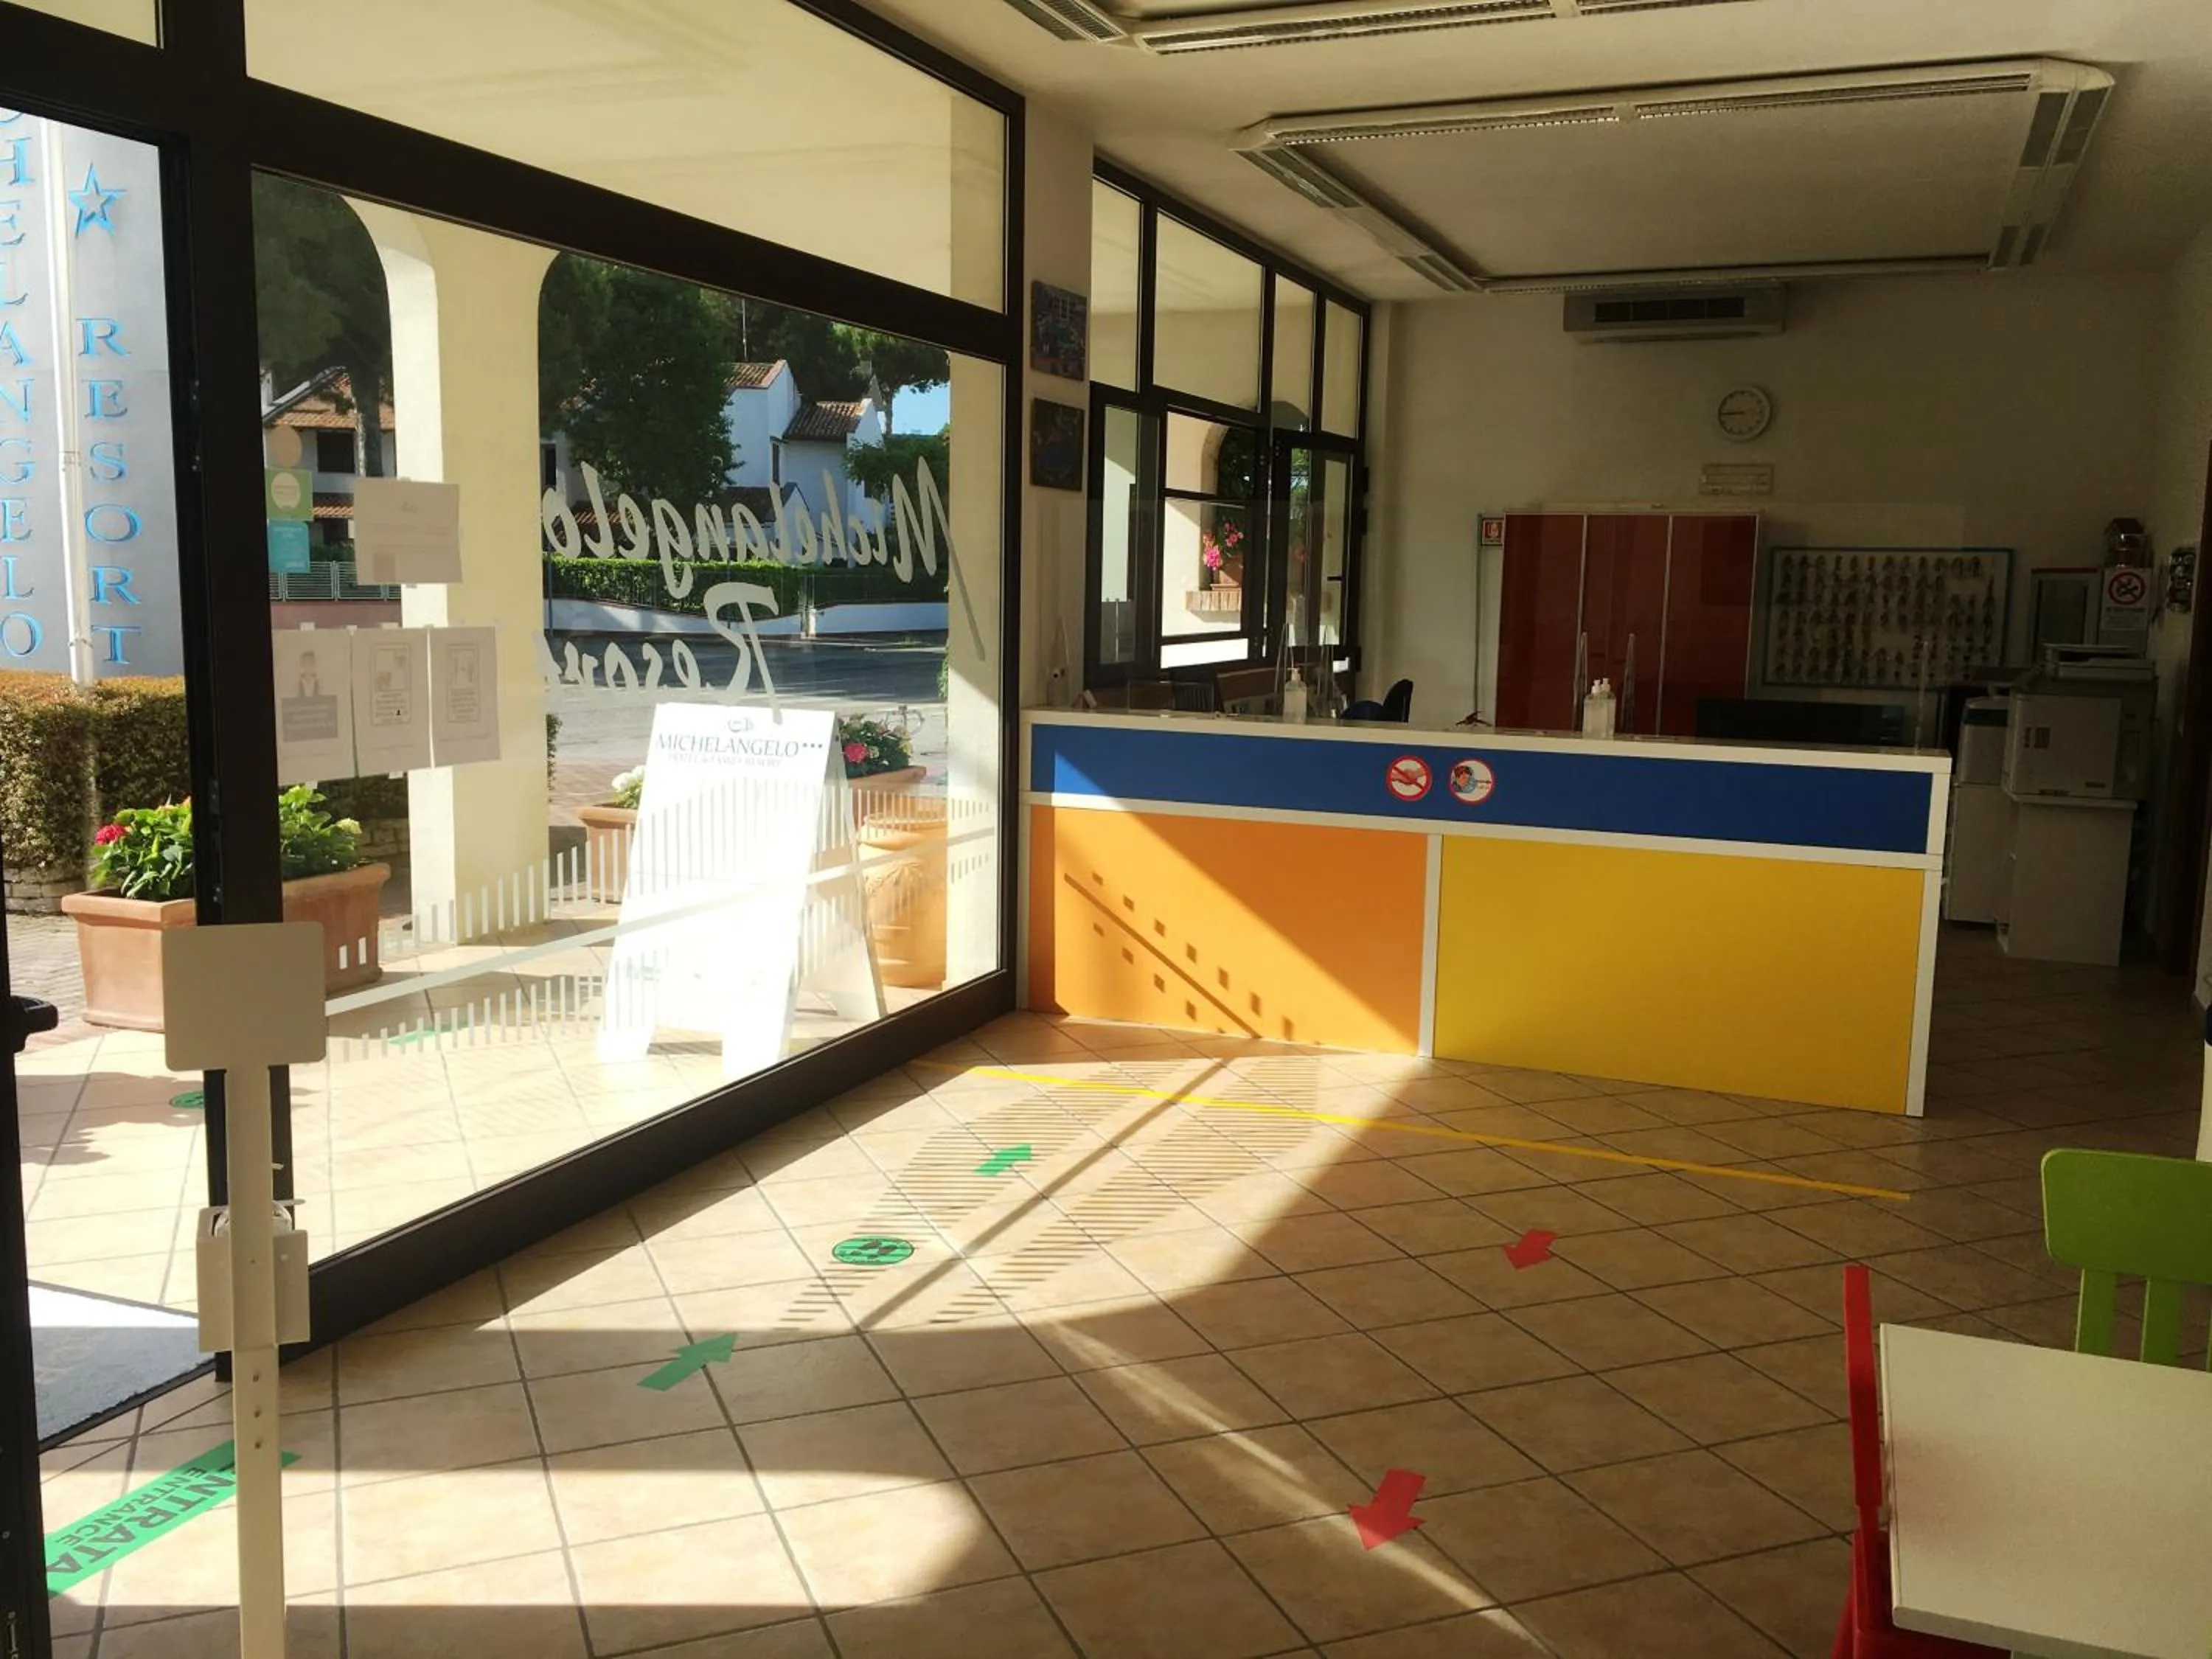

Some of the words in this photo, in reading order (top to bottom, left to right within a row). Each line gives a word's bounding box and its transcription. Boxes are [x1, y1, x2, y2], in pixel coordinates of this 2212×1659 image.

[0, 113, 44, 658] HELANGELO
[76, 317, 143, 664] RESORT
[657, 732, 799, 758] MICHELANGELO
[49, 1461, 236, 1573] NTRATA
[58, 1466, 208, 1546] ENTRANCE
